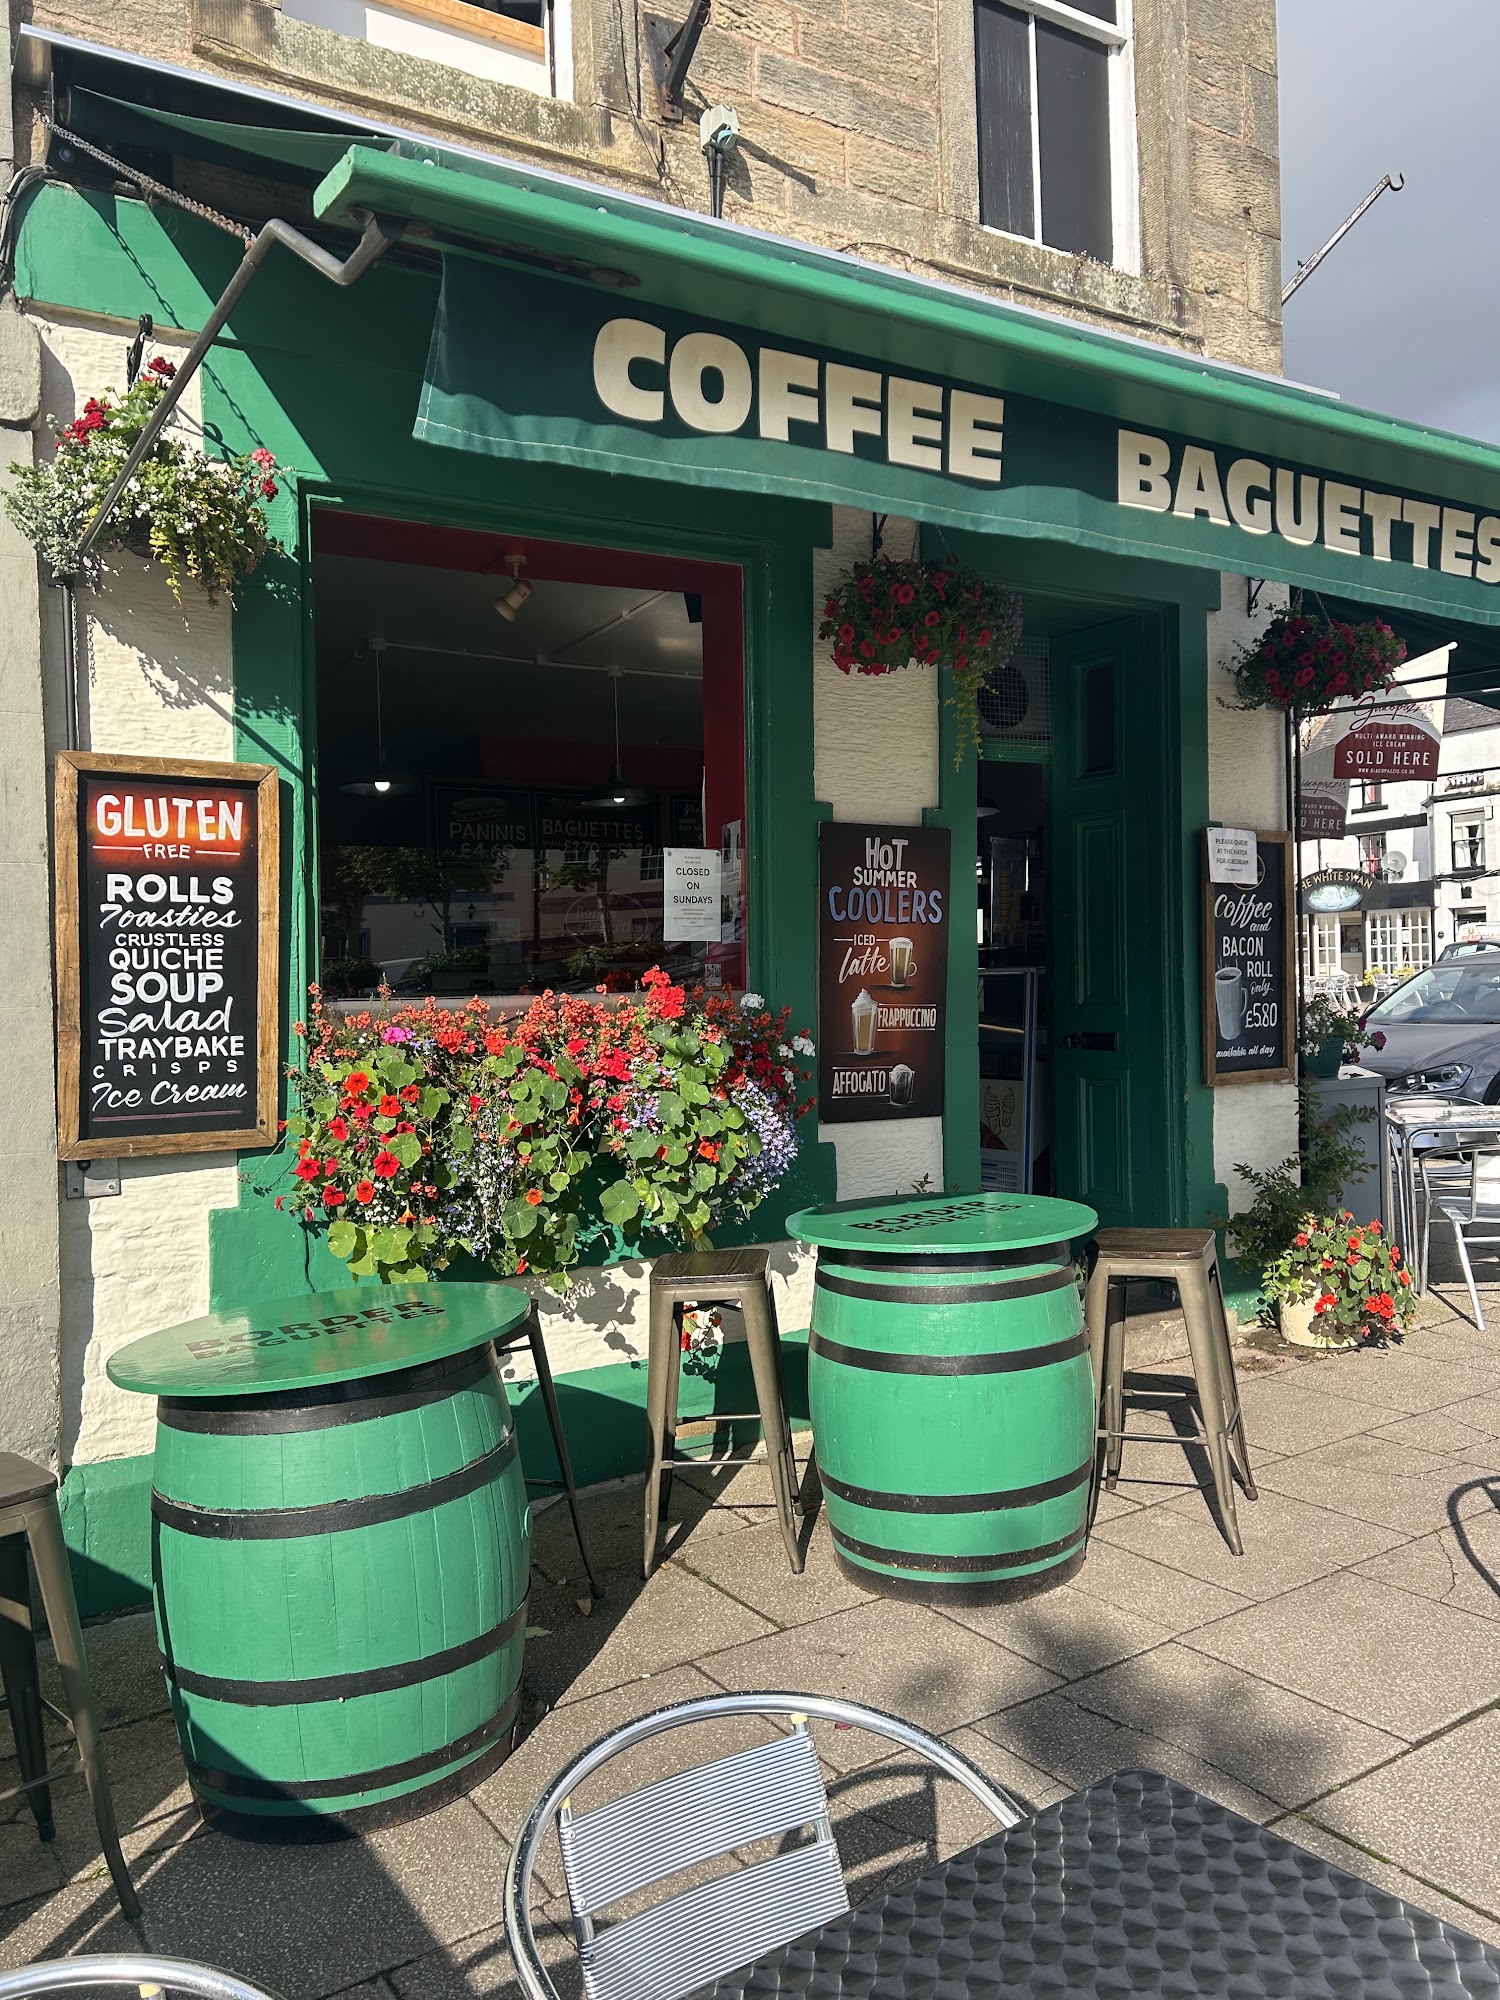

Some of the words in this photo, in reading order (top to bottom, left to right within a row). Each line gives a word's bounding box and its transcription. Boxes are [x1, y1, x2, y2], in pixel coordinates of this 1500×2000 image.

[592, 317, 1006, 483] COFFEE
[1116, 428, 1500, 584] BAGUETTES
[1355, 732, 1396, 740] MULTI-AWARD
[1399, 733, 1426, 741] WINNING
[1346, 750, 1384, 765] SOLD
[1393, 751, 1430, 766] HERE
[95, 793, 244, 842] GLUTEN
[1313, 817, 1342, 830] HERE
[449, 821, 527, 841] PANINIS
[542, 819, 645, 841] BAGUETTES
[142, 842, 192, 860] FREE
[675, 867, 710, 876] CLOSED
[852, 866, 918, 889] SUMMER
[1301, 878, 1313, 892] HE
[1313, 871, 1344, 885] WHITE
[1345, 871, 1374, 890] SWAN
[106, 873, 234, 905] ROLLS
[686, 881, 700, 890] ON
[673, 895, 713, 904] SUNDAYS
[828, 885, 944, 925] COOLERS
[1214, 893, 1273, 929] Coffee
[98, 904, 242, 930] Toasties
[1249, 917, 1273, 933] and
[114, 932, 225, 948] CRUSTLESS
[853, 934, 876, 947] ICED
[1222, 936, 1264, 957] BACON
[108, 947, 224, 972] QUICHE
[838, 946, 891, 985] latte
[1246, 960, 1274, 979] ROLL
[110, 971, 224, 1006] SOUP
[98, 995, 234, 1039] Salad
[877, 1007, 938, 1029] FRAPPUCCINO
[98, 1035, 245, 1062] TRAYBAKE
[1216, 1045, 1247, 1059] available
[1248, 1045, 1260, 1056] all
[1259, 1045, 1276, 1058] day
[832, 1069, 886, 1095] AFFOGATO
[91, 1081, 144, 1112] Ice
[149, 1080, 248, 1106] Cream
[847, 1201, 994, 1231] BORDER
[877, 1203, 1023, 1234] BAGUETTES
[184, 1300, 435, 1353] BORDER
[193, 1306, 446, 1361] BAGUETTES
